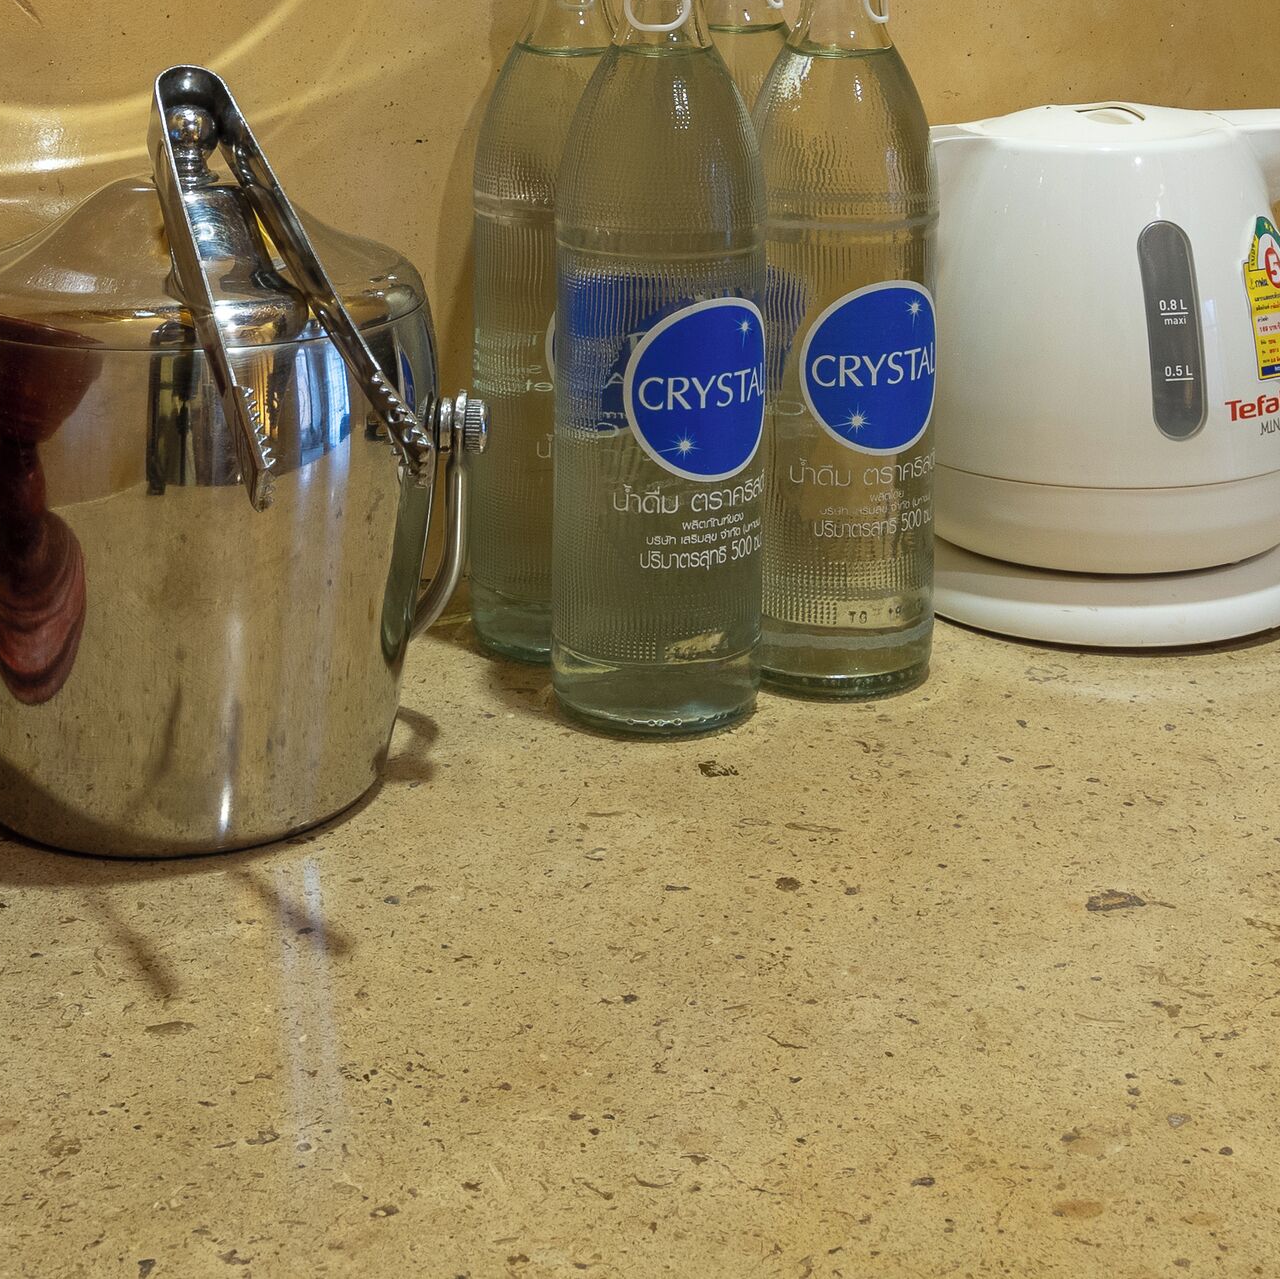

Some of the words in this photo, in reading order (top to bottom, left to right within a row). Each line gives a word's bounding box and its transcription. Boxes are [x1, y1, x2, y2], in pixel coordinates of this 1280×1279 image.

[1159, 299, 1177, 311] 0.8
[1180, 299, 1188, 310] L
[1164, 316, 1187, 325] maxi
[811, 342, 935, 387] CRYSTAL
[1165, 366, 1183, 377] 0.5
[1185, 365, 1193, 376] L
[638, 362, 765, 410] CRYSTAL
[613, 484, 679, 514] น้ำดื่ม
[901, 508, 922, 532] 500
[640, 545, 727, 570] ปริมาตรสุทธิ
[731, 535, 752, 560] 500
